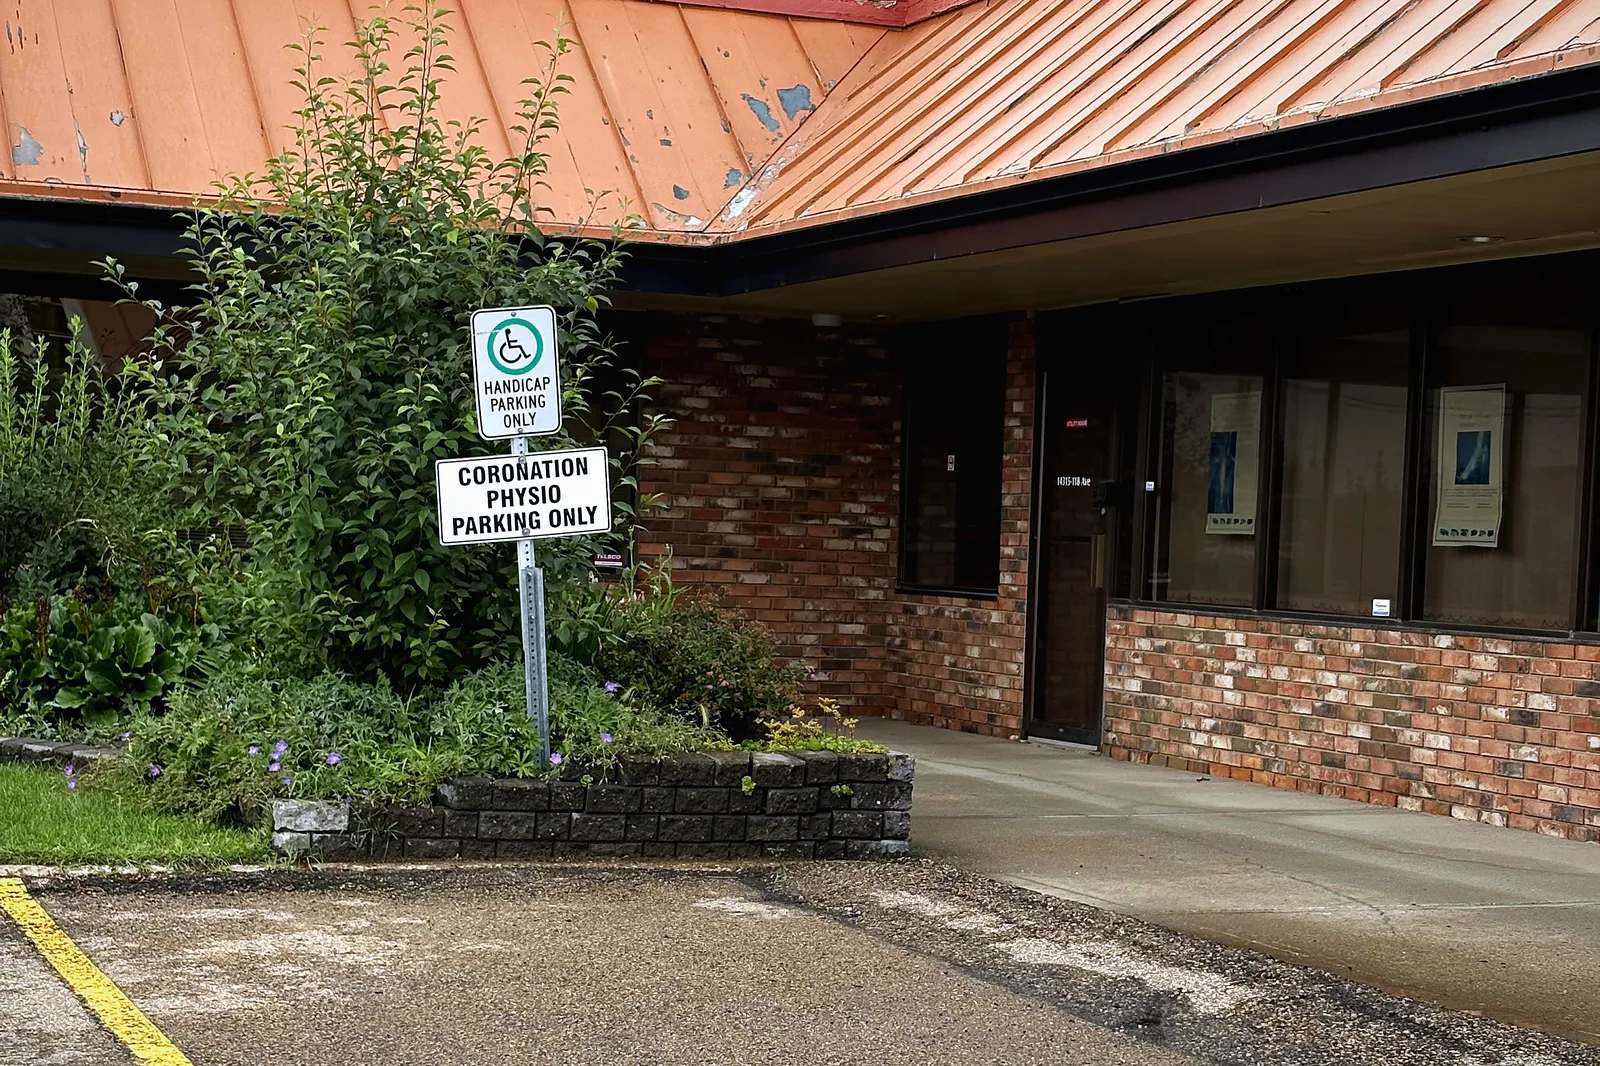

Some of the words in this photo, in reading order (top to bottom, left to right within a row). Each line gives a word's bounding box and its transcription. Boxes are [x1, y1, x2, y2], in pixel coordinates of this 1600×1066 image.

[484, 376, 550, 395] HANDICAP
[490, 394, 546, 412] PARKING
[503, 412, 536, 428] ONLY
[458, 456, 588, 486] CORONATION
[487, 484, 561, 509] PHYSIO
[452, 510, 541, 536] PARKING
[549, 505, 597, 528] ONLY
